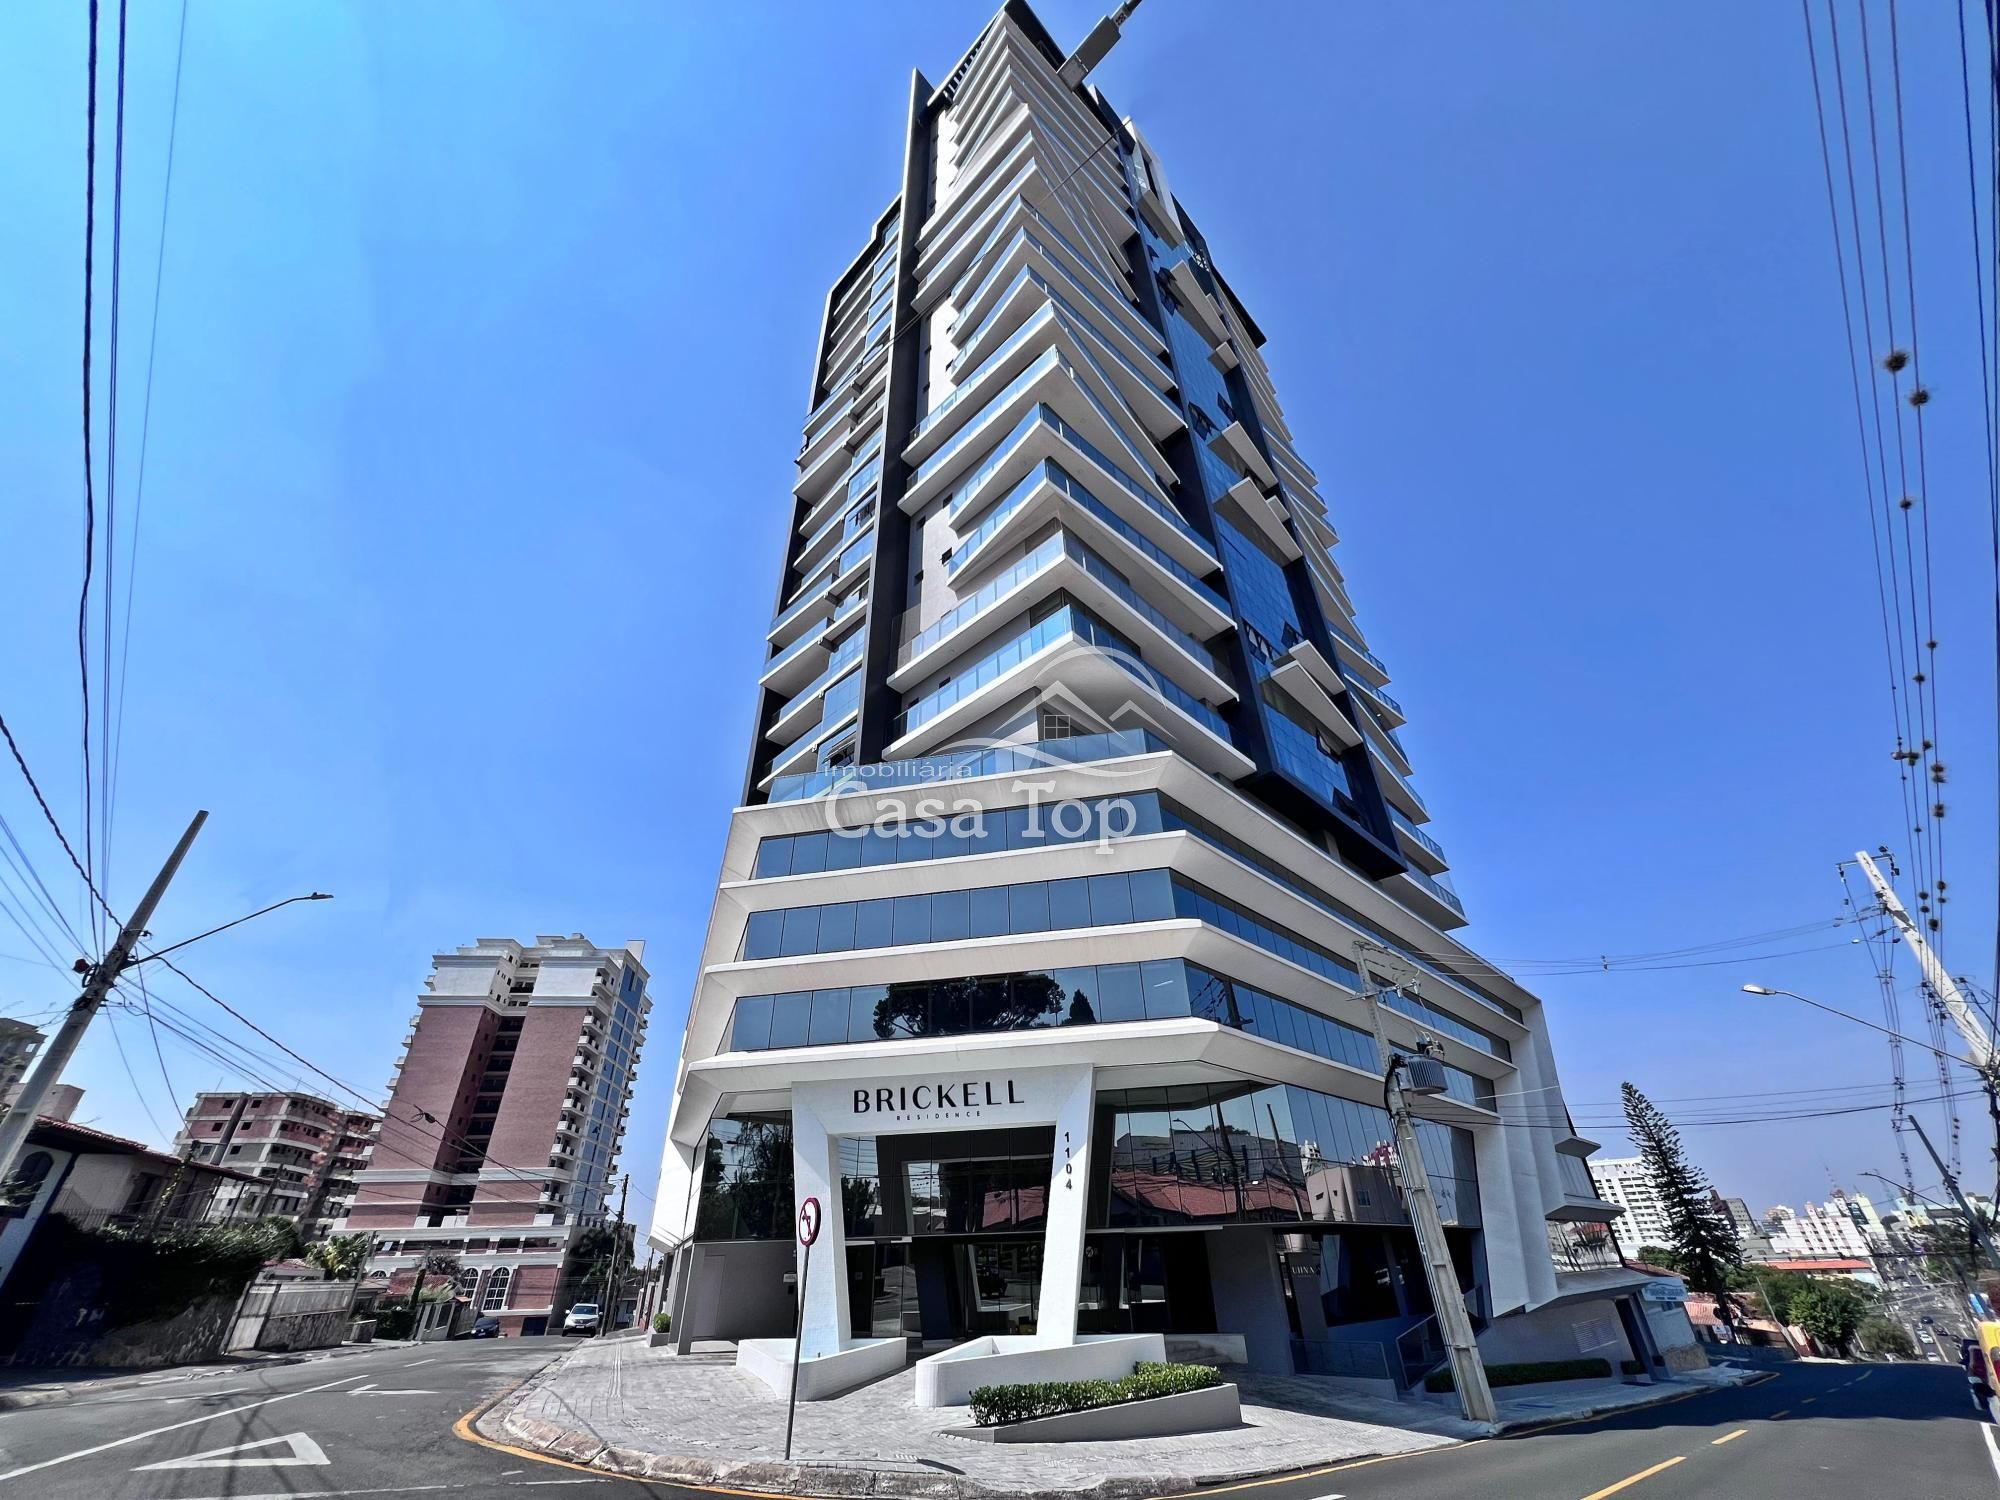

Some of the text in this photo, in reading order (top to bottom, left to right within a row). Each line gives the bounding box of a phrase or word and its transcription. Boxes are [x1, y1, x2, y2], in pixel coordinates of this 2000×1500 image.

[853, 1080, 1025, 1113] BRICKELL
[896, 1110, 980, 1121] RESIDENCE
[1064, 1131, 1073, 1190] 1104
